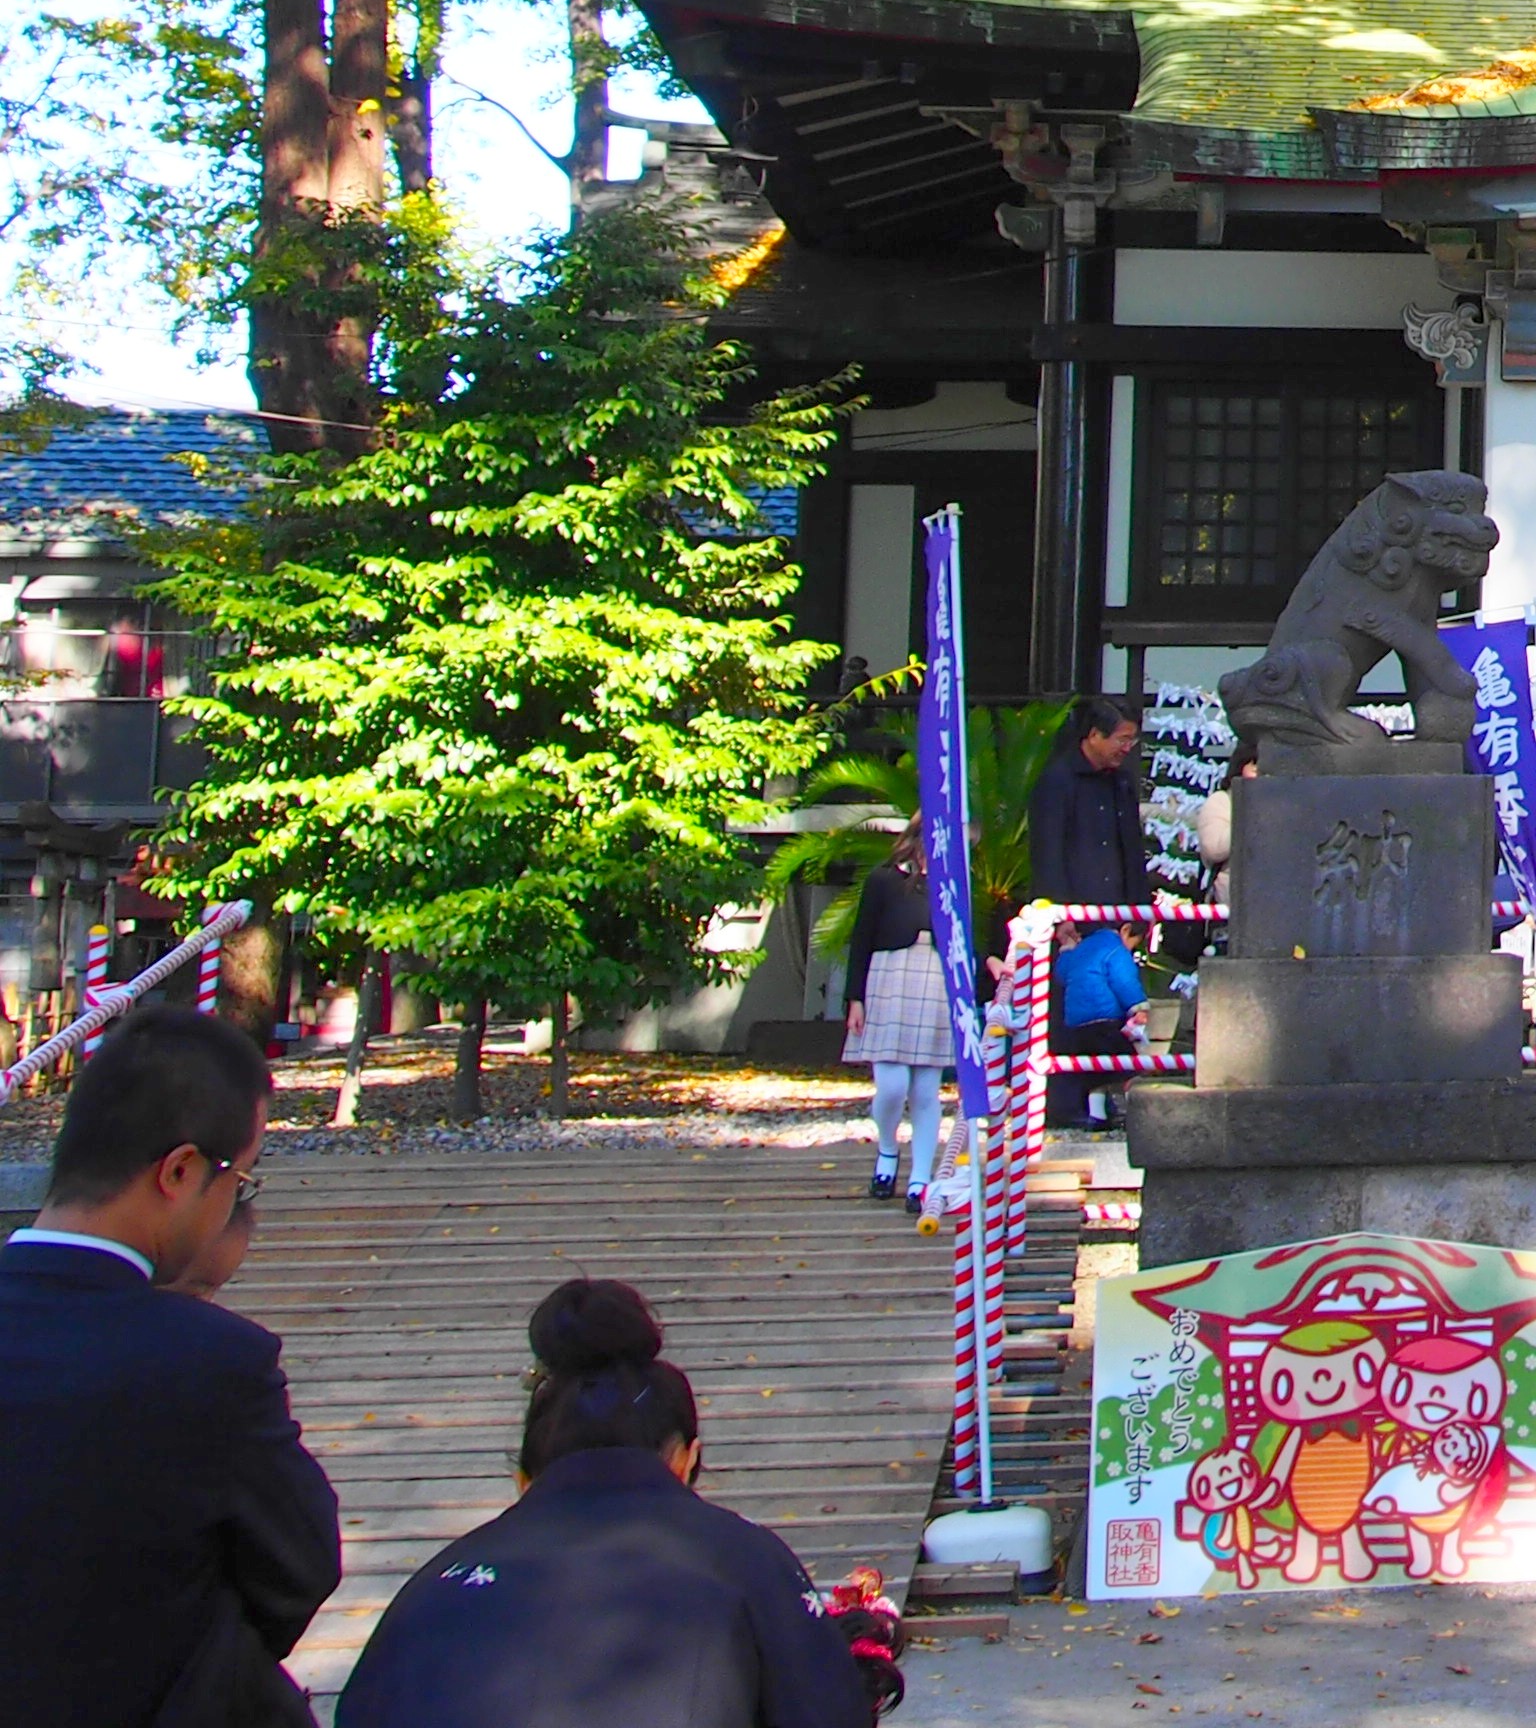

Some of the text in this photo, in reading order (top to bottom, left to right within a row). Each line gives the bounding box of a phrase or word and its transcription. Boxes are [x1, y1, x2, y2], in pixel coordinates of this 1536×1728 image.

[1124, 1352, 1160, 1505] ございます
[1169, 1309, 1199, 1454] おめでとう
